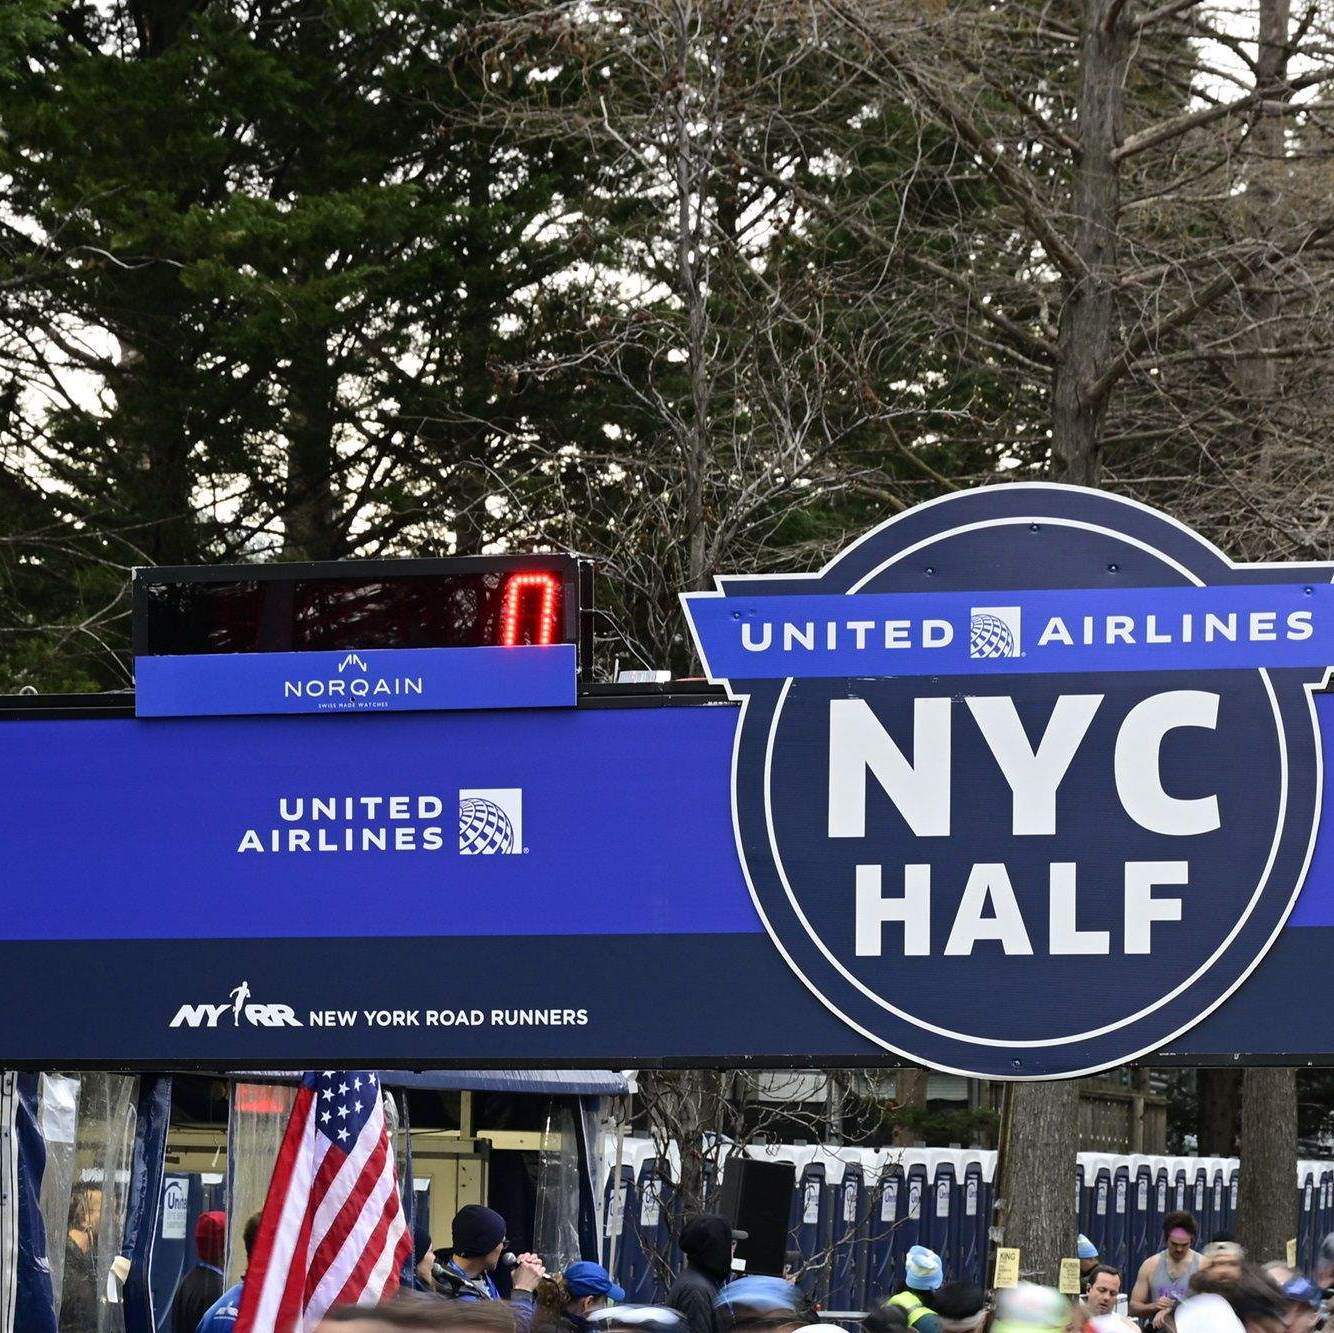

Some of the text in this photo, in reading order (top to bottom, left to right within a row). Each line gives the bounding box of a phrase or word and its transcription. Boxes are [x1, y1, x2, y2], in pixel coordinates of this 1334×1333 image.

[741, 611, 1313, 652] UNITED AIRLINES
[285, 677, 423, 698] NORQAIN
[828, 690, 1220, 837] NYC
[280, 796, 442, 821] UNITED
[238, 827, 442, 852] AIRLINES
[856, 861, 1188, 956] HALF
[310, 1011, 357, 1026] NEW
[364, 1011, 419, 1026] YORK
[427, 1010, 484, 1025] ROAD
[492, 1009, 588, 1025] RUNNERS
